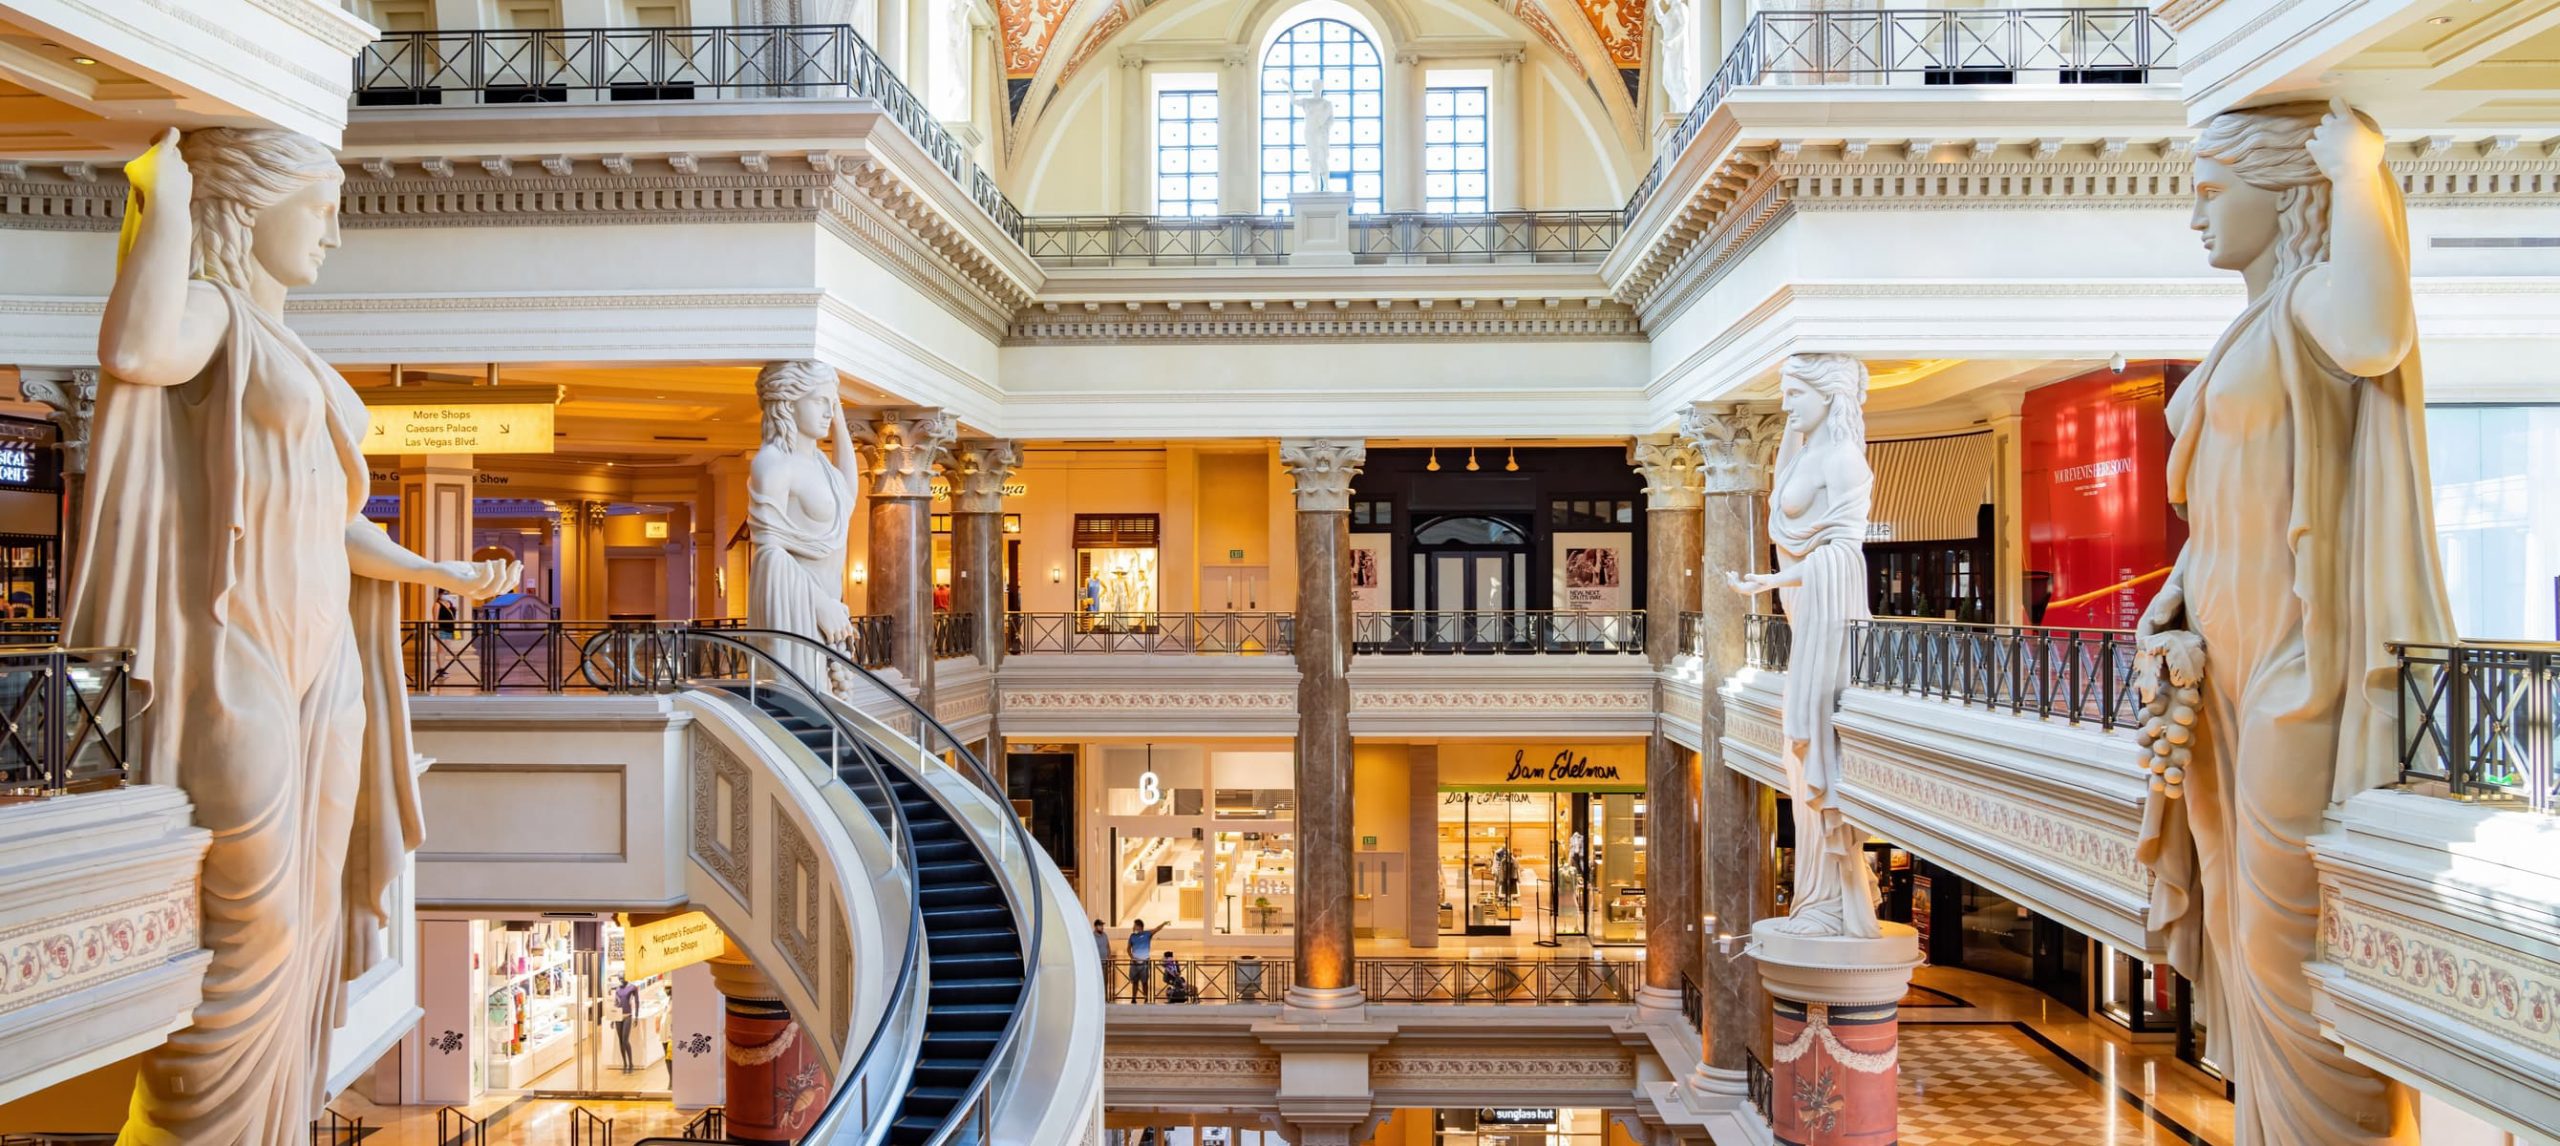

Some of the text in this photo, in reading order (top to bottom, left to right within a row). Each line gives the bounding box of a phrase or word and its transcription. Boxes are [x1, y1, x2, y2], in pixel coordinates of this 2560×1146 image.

[413, 410, 471, 420] More Shops
[405, 424, 478, 433] Caesars Palace
[405, 437, 479, 448] Las Vegas Blvd.
[480, 473, 509, 484] Show
[2054, 467, 2070, 484] YOUR
[2069, 463, 2093, 482] EVENTS
[1506, 749, 1620, 782] Sam Edelman
[652, 921, 708, 944] Neptune's Fountain
[663, 941, 698, 956] More Shops
[1496, 1108, 1554, 1122] sunglass hut
